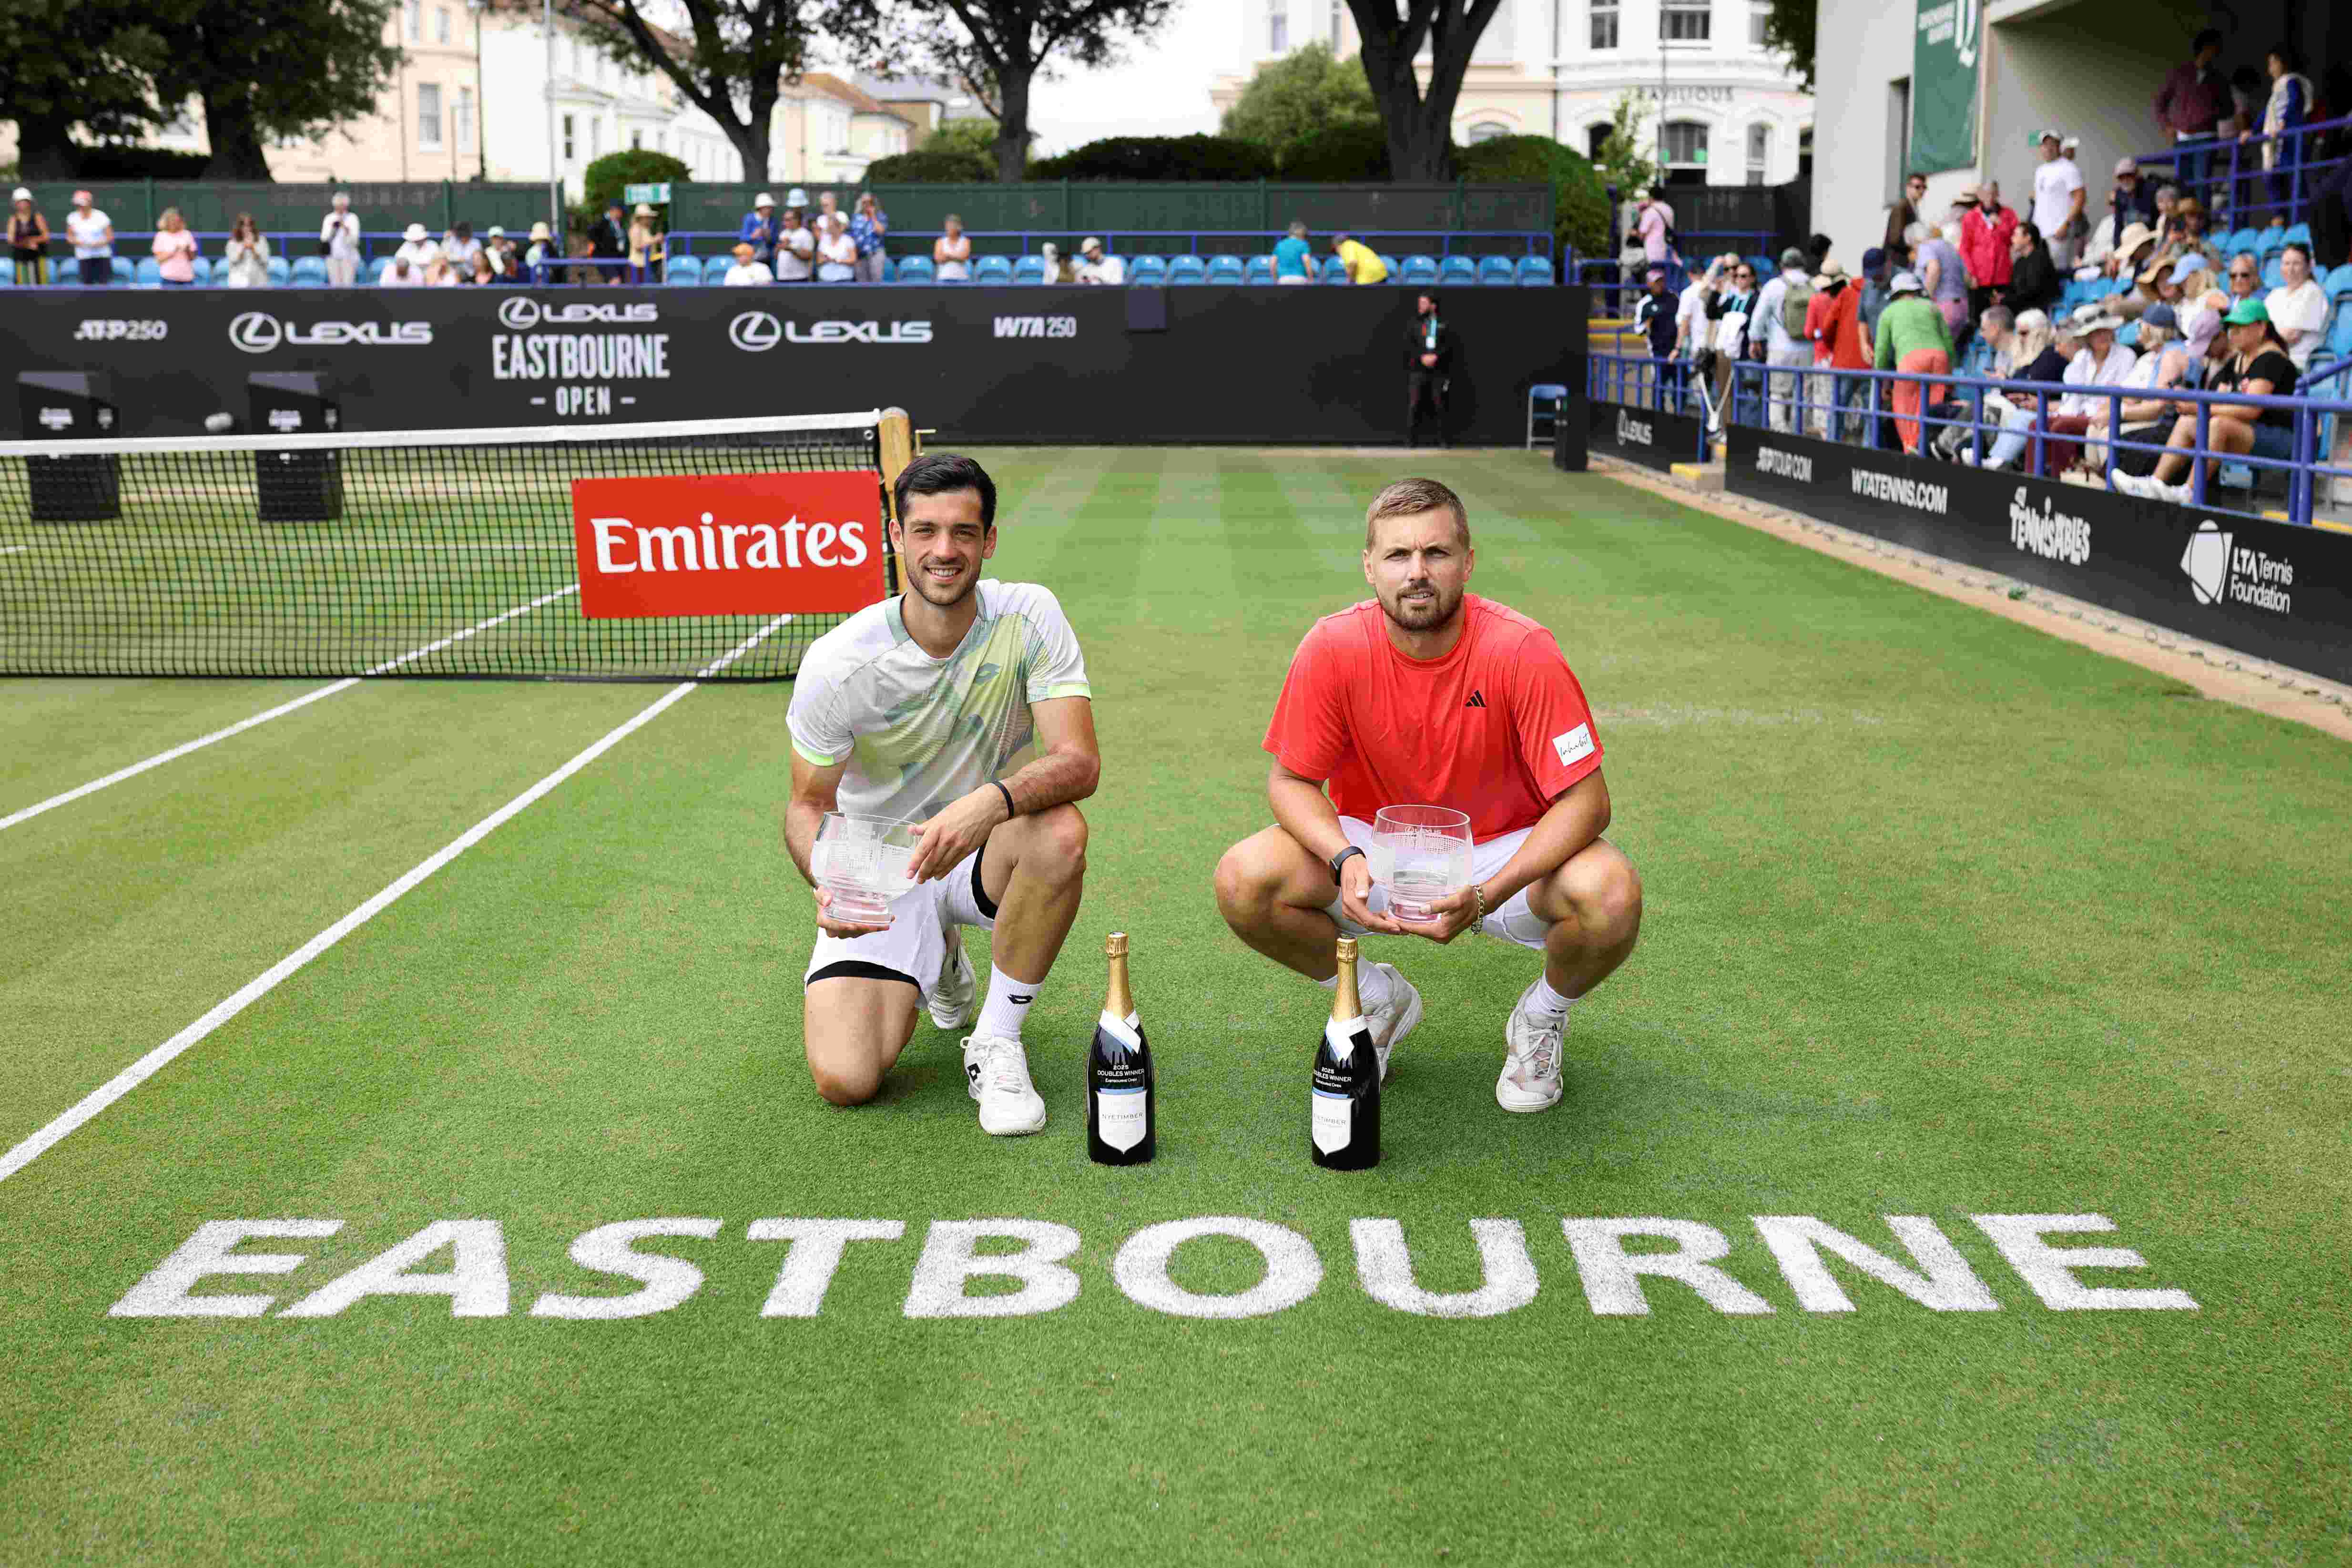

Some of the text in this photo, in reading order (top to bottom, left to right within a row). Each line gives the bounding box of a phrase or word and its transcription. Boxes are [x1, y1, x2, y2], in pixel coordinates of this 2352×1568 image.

[542, 303, 659, 323] LEXUS
[785, 321, 934, 343] LEXUS
[285, 322, 433, 345] LEXUS
[492, 334, 670, 379] EASTBOURNE
[555, 386, 611, 416] OPEN
[1851, 467, 1948, 515] WTATENNIS.COM
[591, 511, 867, 573] Emirates
[2232, 547, 2293, 586] LTA Tennis
[2230, 573, 2291, 614] Foundation
[1329, 1075, 1352, 1083] WINNER
[110, 1213, 2198, 1320] EASTBOURNE
